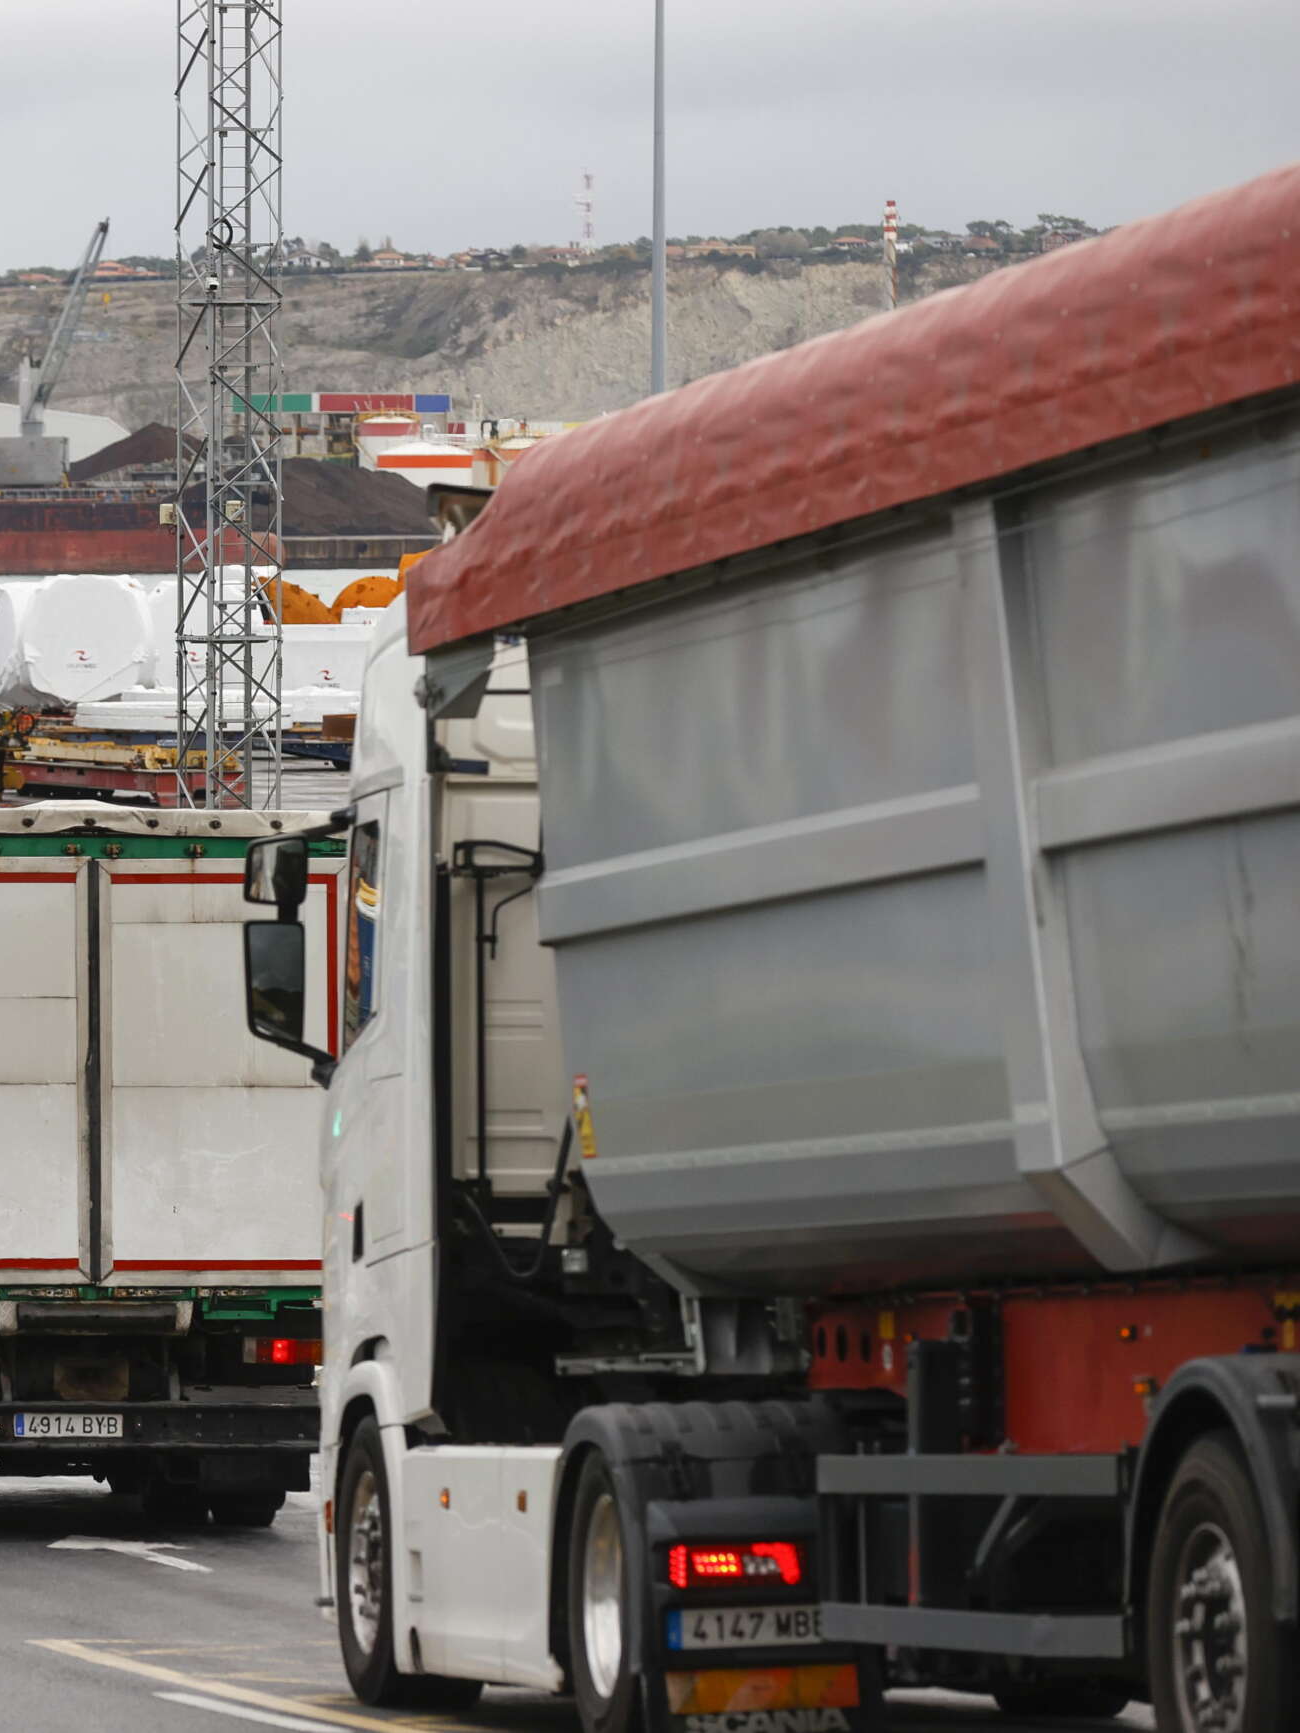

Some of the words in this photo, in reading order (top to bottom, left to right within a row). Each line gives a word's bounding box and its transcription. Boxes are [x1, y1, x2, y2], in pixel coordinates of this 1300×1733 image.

[28, 1416, 75, 1434] 4914
[82, 1416, 118, 1434] BYB
[693, 1612, 764, 1641] 4147
